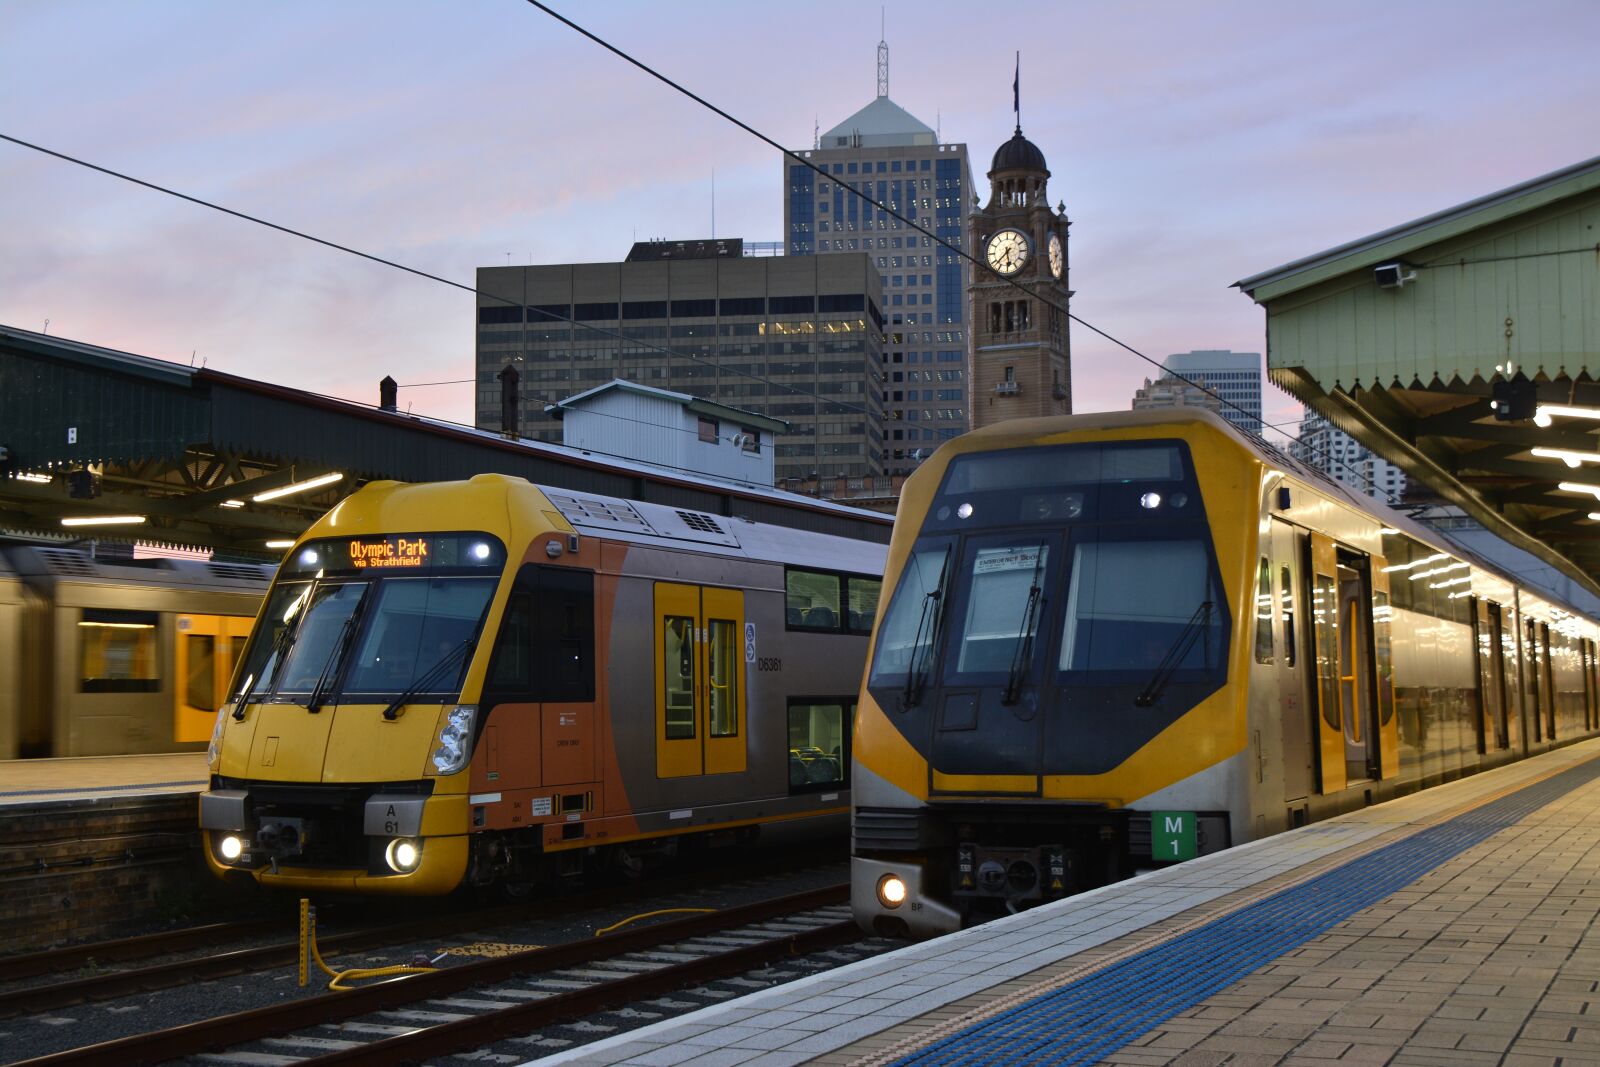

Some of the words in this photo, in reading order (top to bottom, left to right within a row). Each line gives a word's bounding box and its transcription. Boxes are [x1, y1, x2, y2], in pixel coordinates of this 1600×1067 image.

[350, 540, 394, 558] Olympic
[398, 538, 427, 556] Park
[353, 559, 367, 567] via
[370, 556, 421, 567] Strathfield
[758, 657, 782, 671] D6361
[386, 804, 396, 817] A
[384, 821, 399, 834] 61
[1165, 816, 1182, 833] M
[1170, 839, 1178, 856] 1
[911, 902, 923, 912] BP
